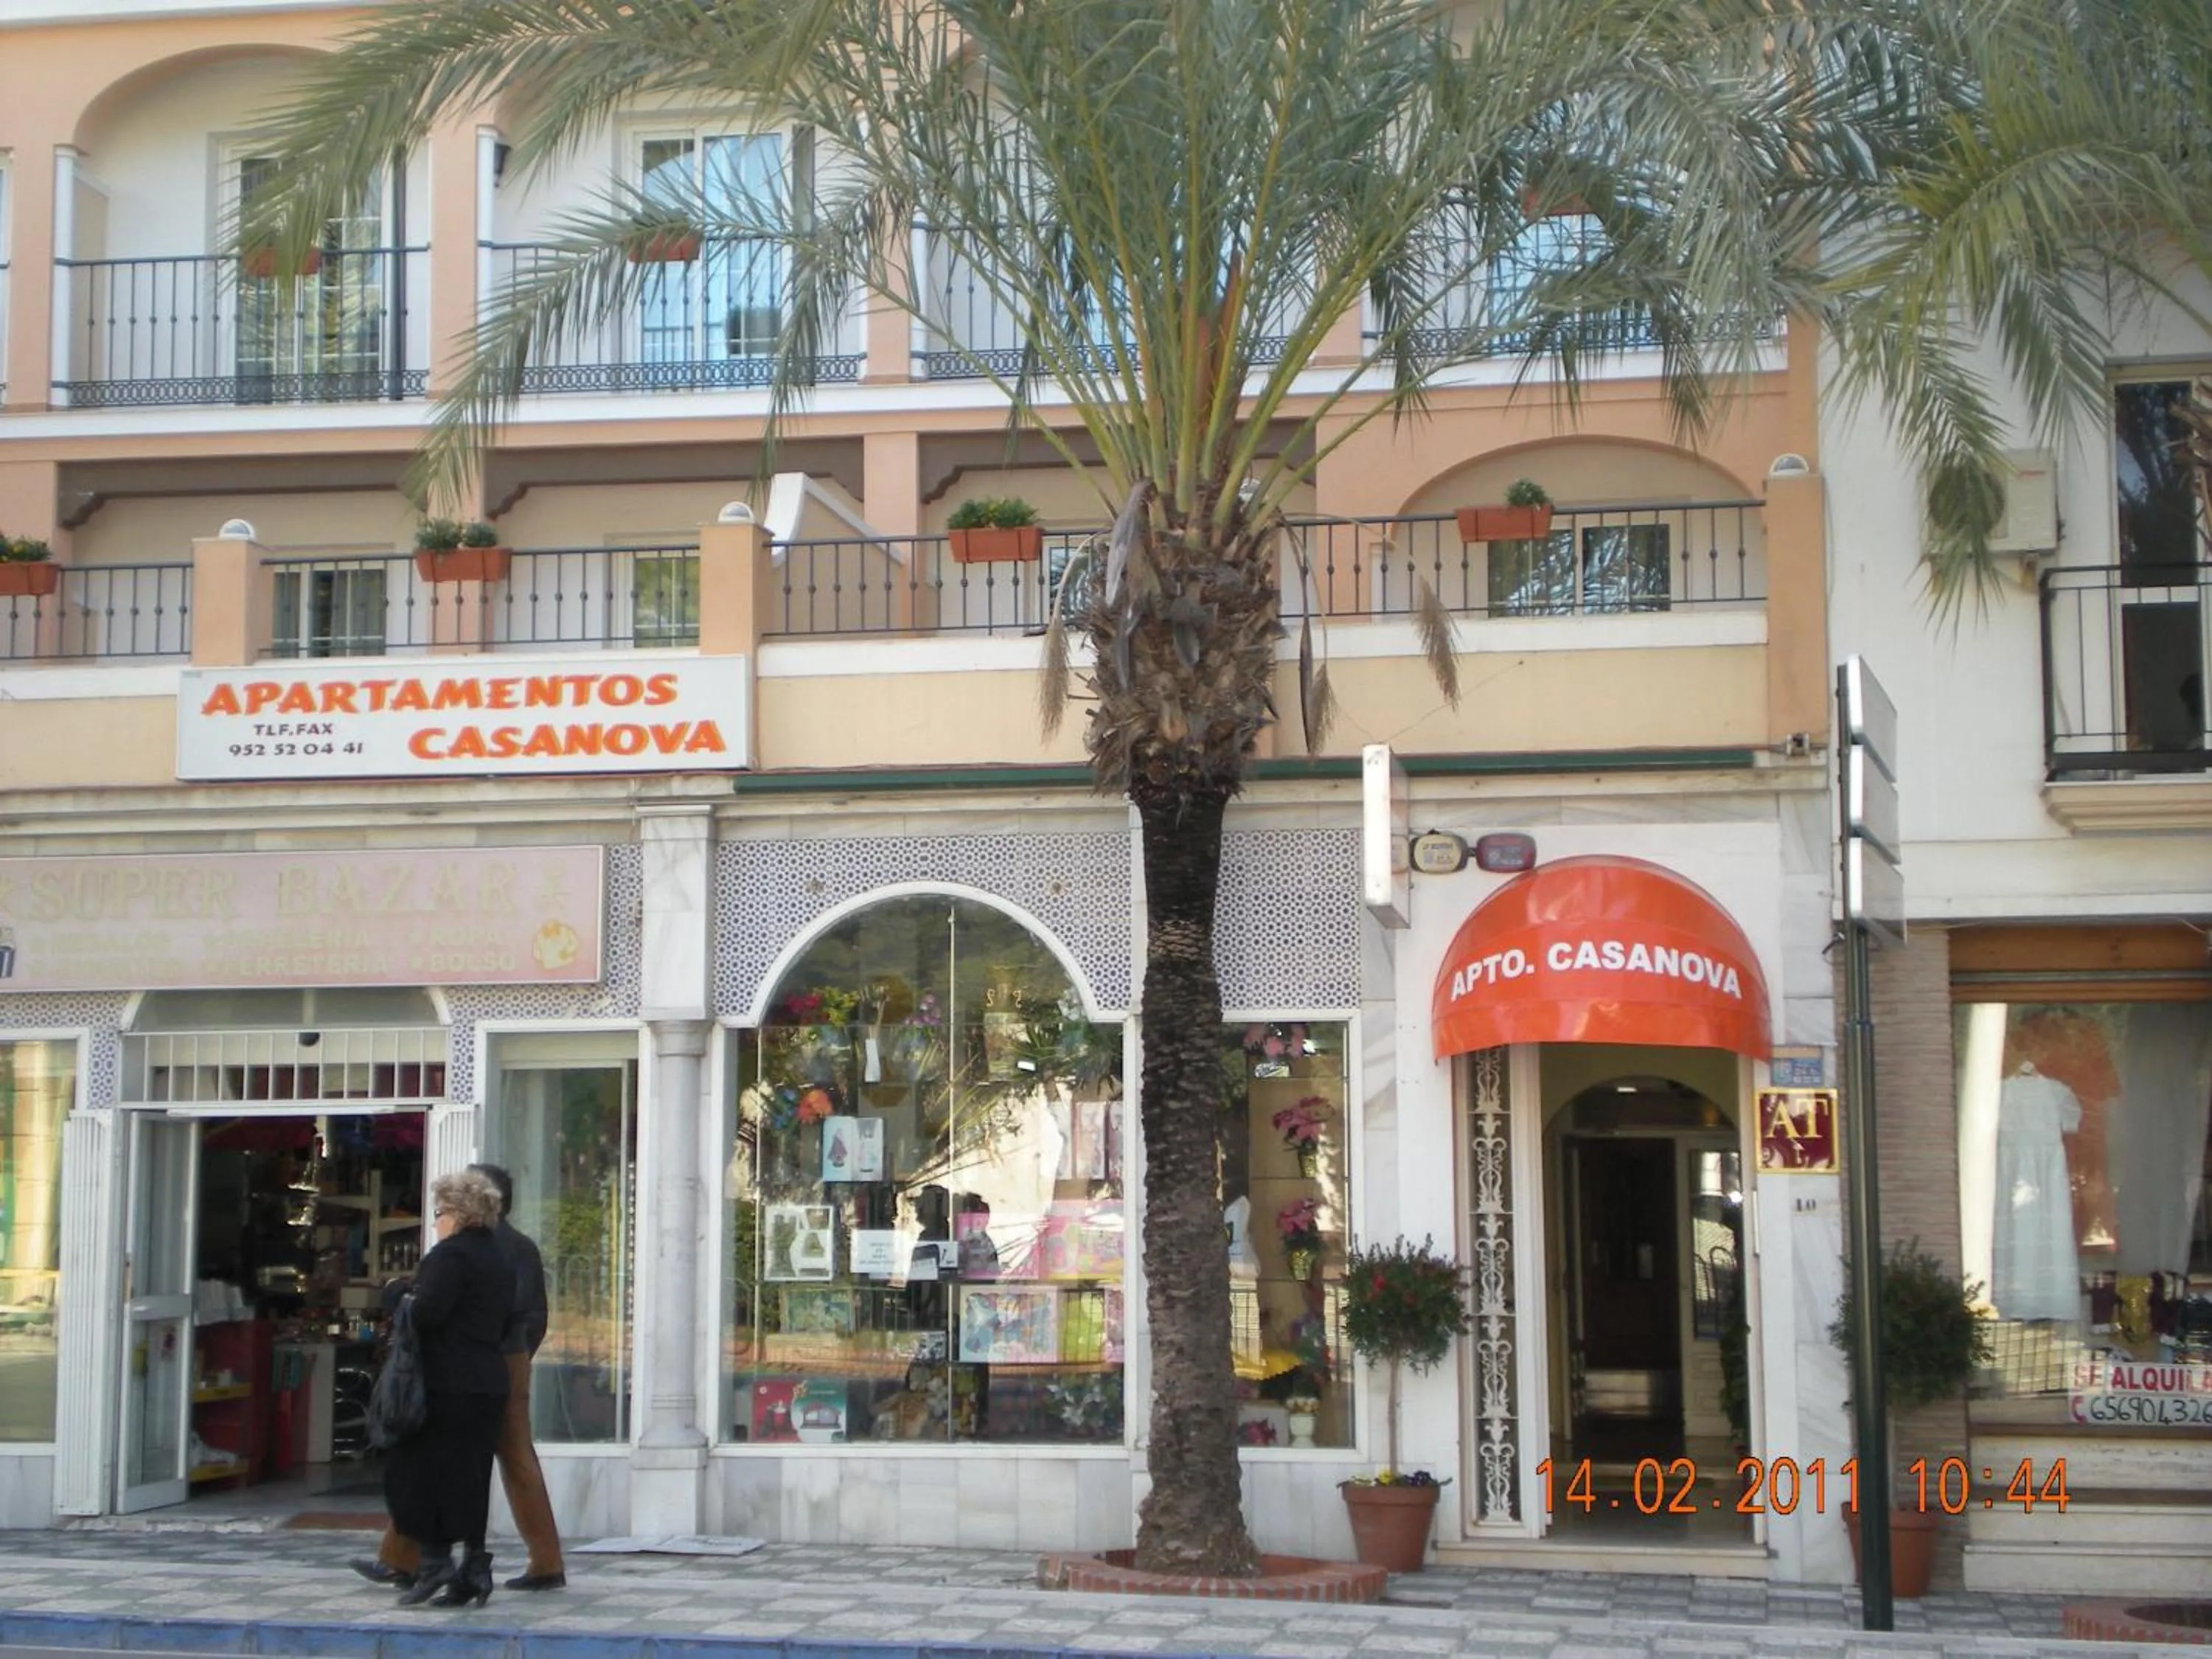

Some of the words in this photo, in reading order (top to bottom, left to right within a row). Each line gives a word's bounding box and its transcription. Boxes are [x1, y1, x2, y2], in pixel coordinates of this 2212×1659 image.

[201, 673, 679, 717] APARTAMENTOS
[229, 744, 265, 757] 952
[274, 743, 296, 756] 52
[302, 742, 334, 756] 04
[343, 742, 364, 754] 41
[254, 723, 333, 737] TLF.FAX
[408, 720, 726, 761] CASANOVA
[30, 866, 242, 922] SUPER
[276, 858, 521, 918] BAZAR
[1450, 950, 1534, 1001] APTO.
[1548, 941, 1741, 998] CASANOVA
[1764, 1098, 1829, 1139] AT
